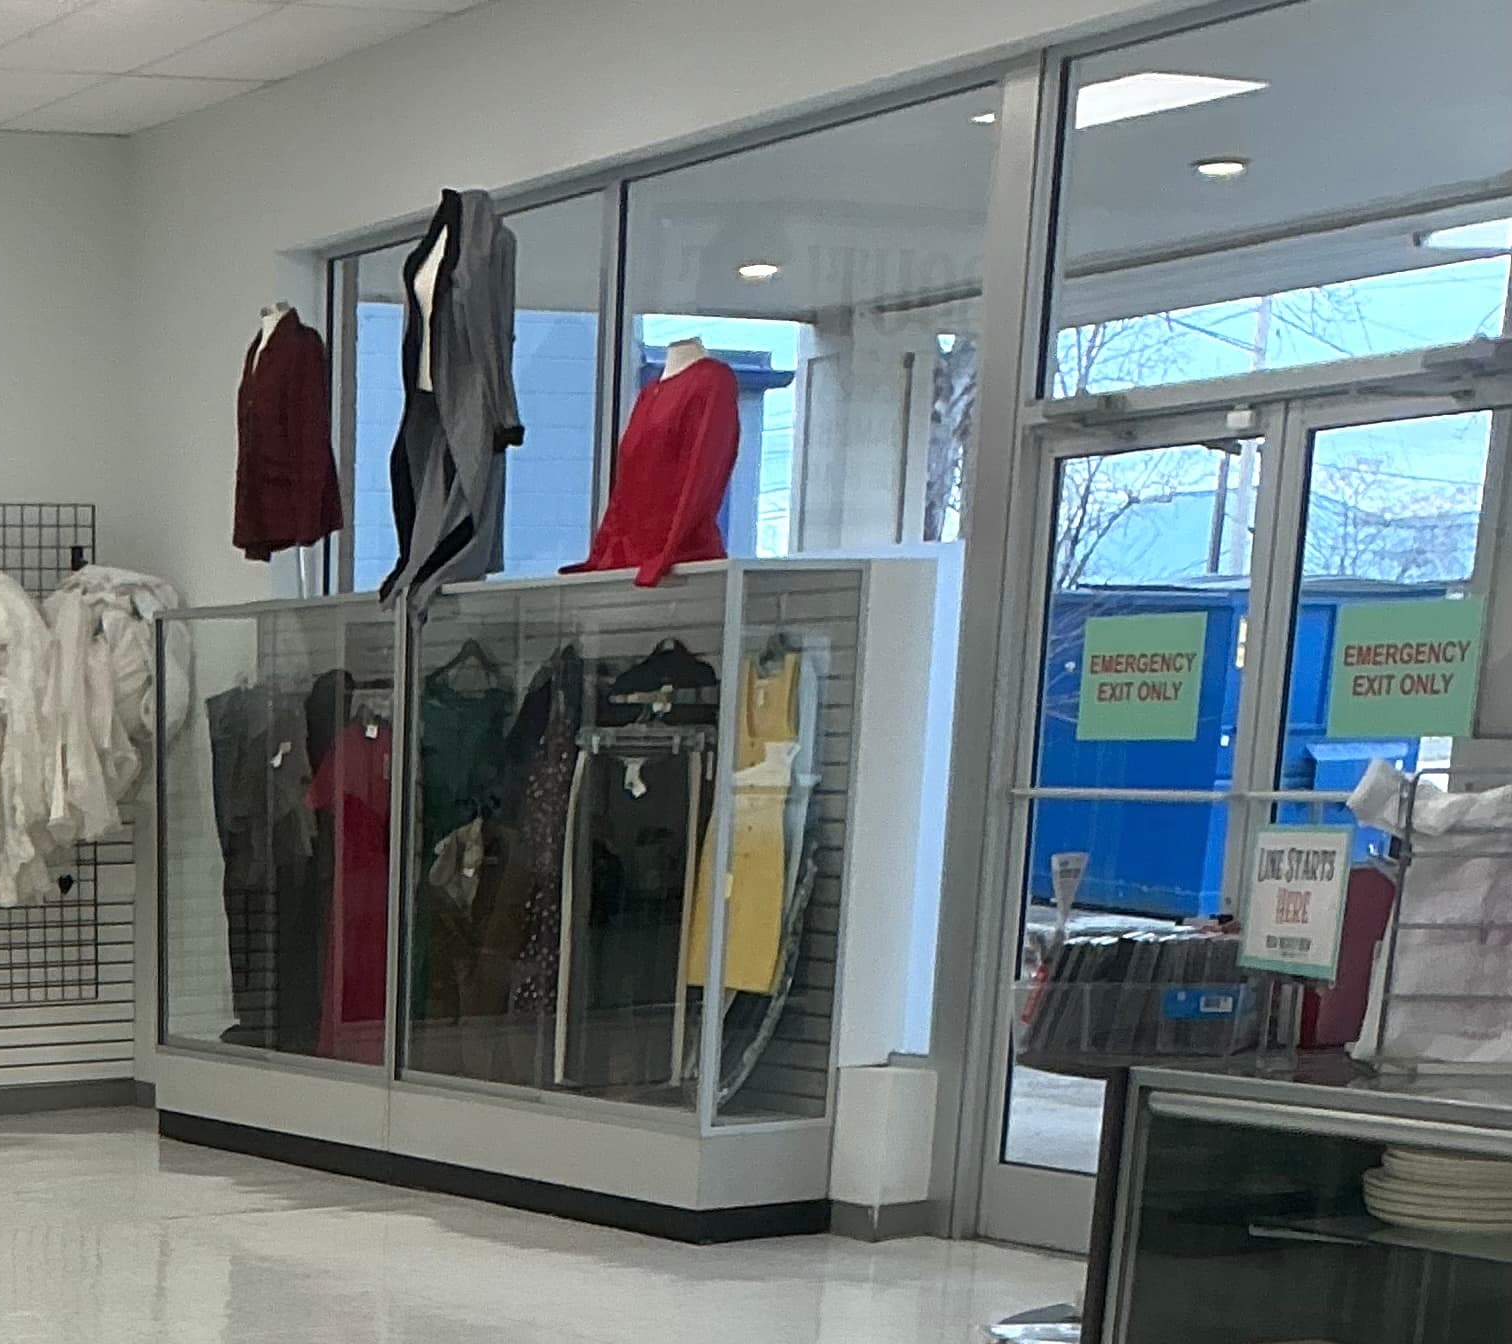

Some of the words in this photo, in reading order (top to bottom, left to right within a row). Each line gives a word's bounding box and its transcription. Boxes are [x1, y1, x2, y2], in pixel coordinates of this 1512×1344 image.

[1090, 652, 1197, 674] EMERGENCY
[1343, 640, 1471, 667] EMERGENCY
[1097, 682, 1134, 703] EXIT
[1137, 681, 1183, 701] ONLY
[1352, 674, 1396, 696] EXIT
[1399, 672, 1454, 695] ONLY
[1257, 848, 1285, 882] LINE
[1286, 848, 1337, 883] STARTS
[1274, 887, 1312, 925] HERE
